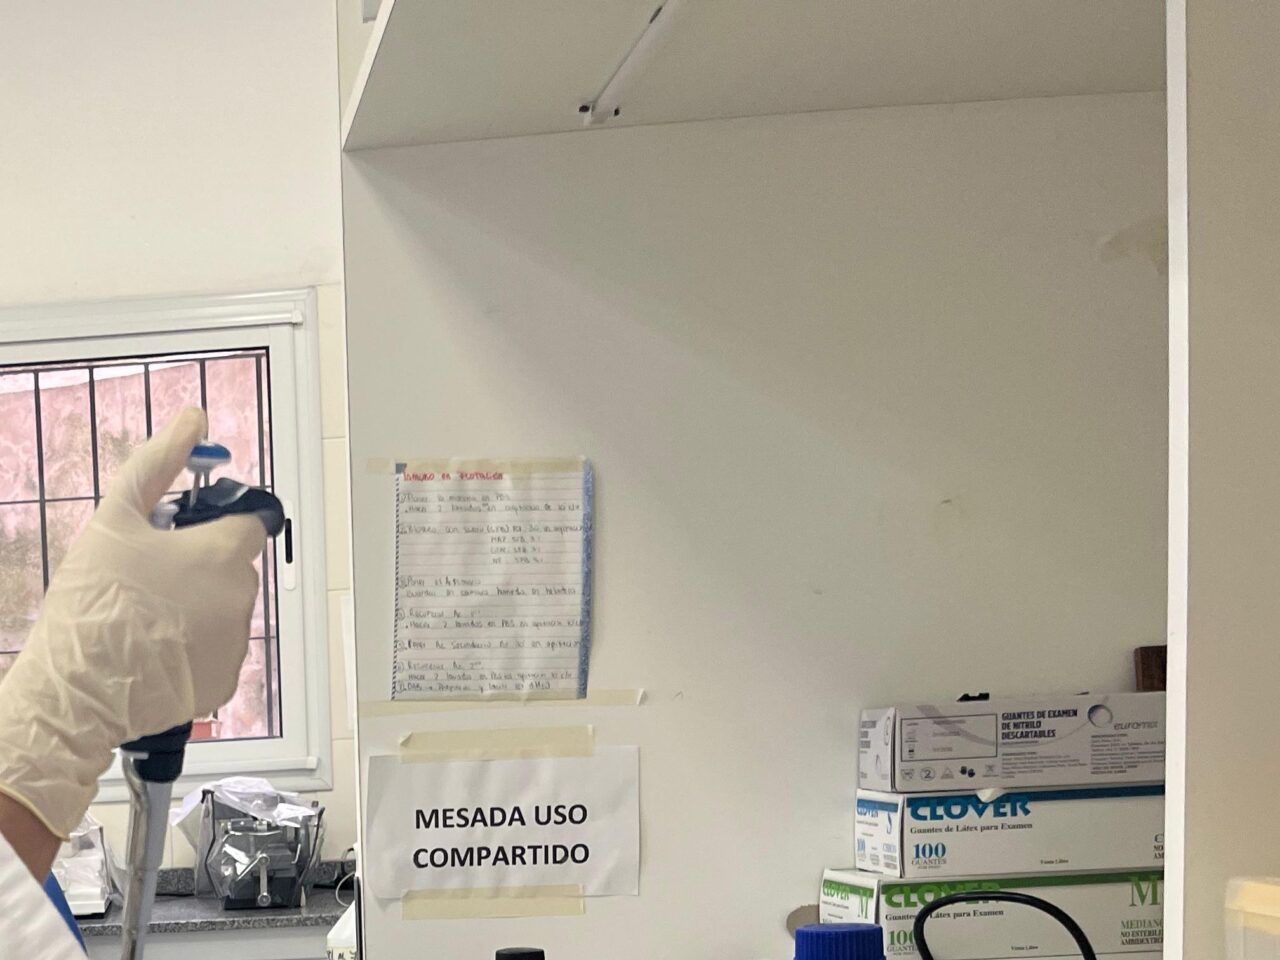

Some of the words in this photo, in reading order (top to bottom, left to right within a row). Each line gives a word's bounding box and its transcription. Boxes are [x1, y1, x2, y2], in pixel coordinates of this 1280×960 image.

[1002, 711, 1035, 721] GUANTES
[1037, 710, 1046, 719] DE
[1048, 709, 1078, 718] EXAMEN
[1002, 721, 1011, 730] DE
[1013, 720, 1042, 730] NITRILO
[1002, 729, 1056, 740] DESCARTABLES
[415, 806, 526, 829] MESADA
[534, 804, 588, 825] USO
[910, 826, 943, 835] Guantes
[944, 825, 954, 833] de
[980, 825, 999, 833] para
[1001, 822, 1033, 830] Examen
[413, 843, 590, 869] COMPARTIDO
[913, 842, 947, 859] 100
[1128, 874, 1161, 907] M
[953, 911, 971, 919] para
[973, 908, 1004, 917] Examen
